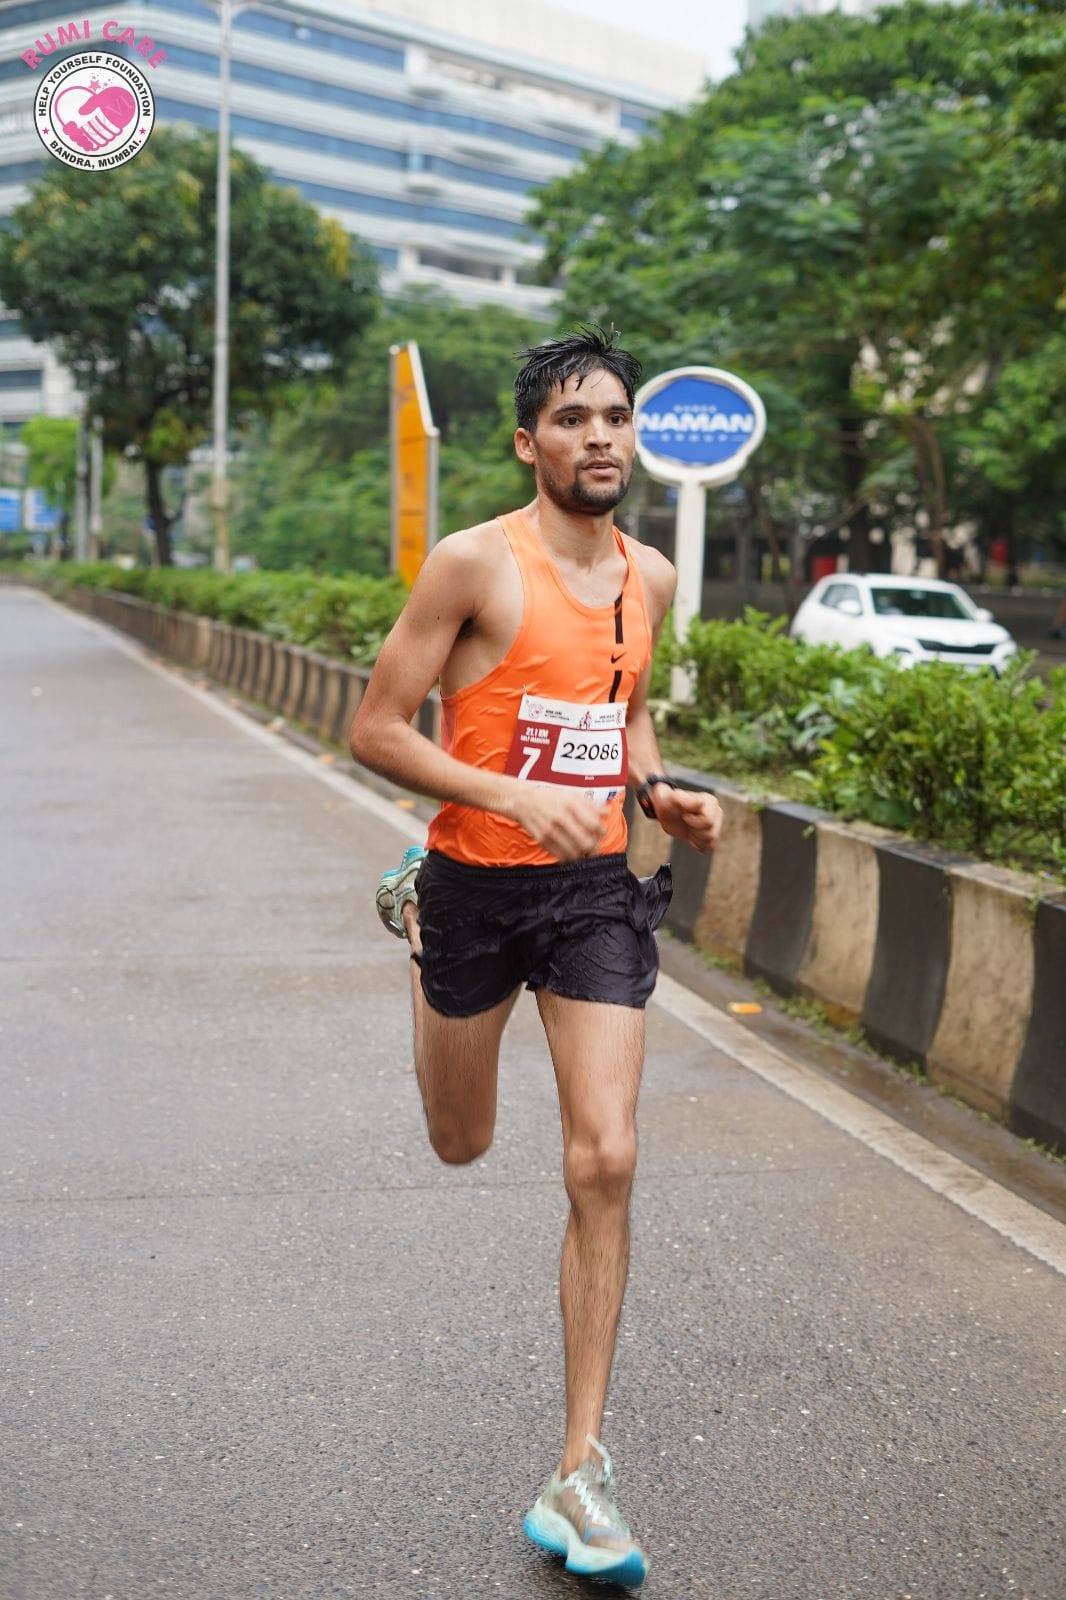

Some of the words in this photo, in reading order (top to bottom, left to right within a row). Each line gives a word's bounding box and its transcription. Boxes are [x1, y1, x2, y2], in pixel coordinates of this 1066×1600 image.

[637, 411, 754, 433] NAMAN
[560, 742, 619, 761] 22086
[518, 746, 542, 781] 7
